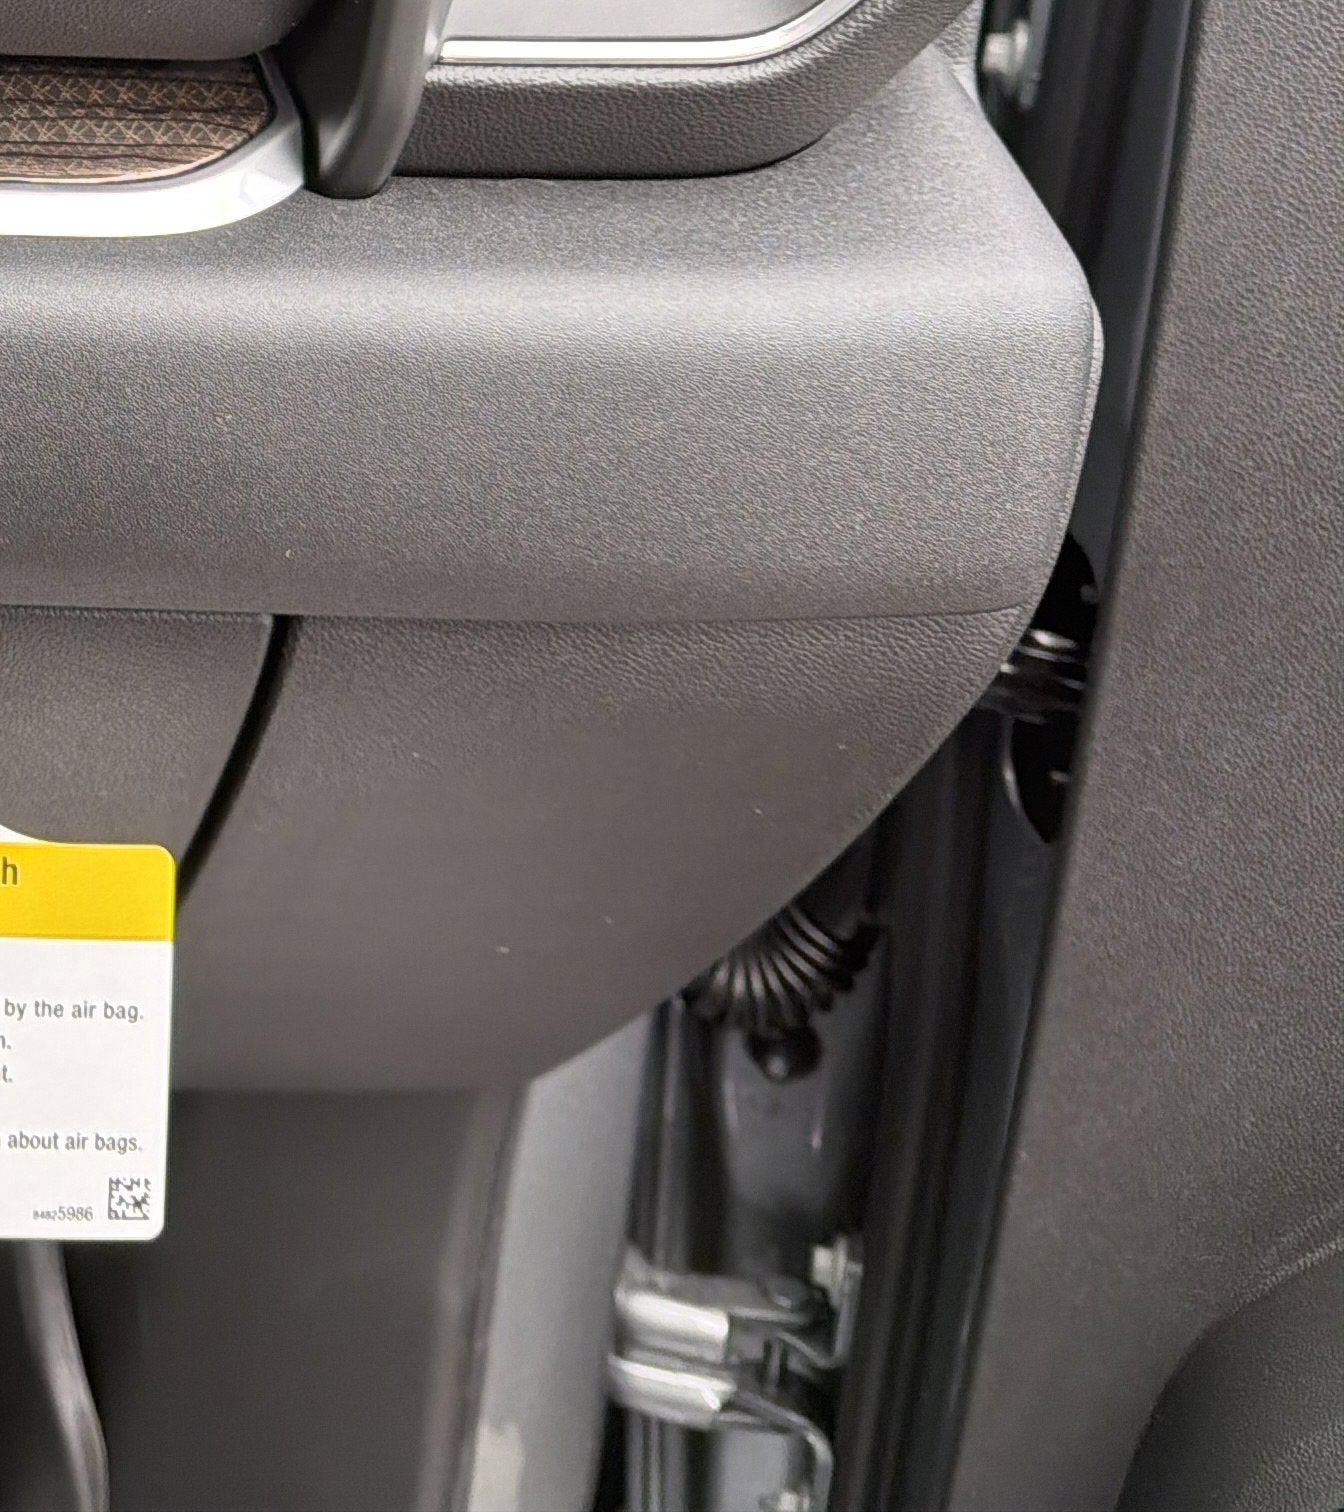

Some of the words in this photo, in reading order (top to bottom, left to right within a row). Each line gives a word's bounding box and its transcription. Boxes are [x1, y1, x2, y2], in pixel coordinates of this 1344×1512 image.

[4, 998, 27, 1021] by
[34, 1000, 64, 1018] the
[72, 1000, 96, 1019] air
[104, 1001, 143, 1023] bag.
[8, 1131, 59, 1150] about
[65, 1132, 88, 1150] air
[95, 1133, 142, 1155] bags.
